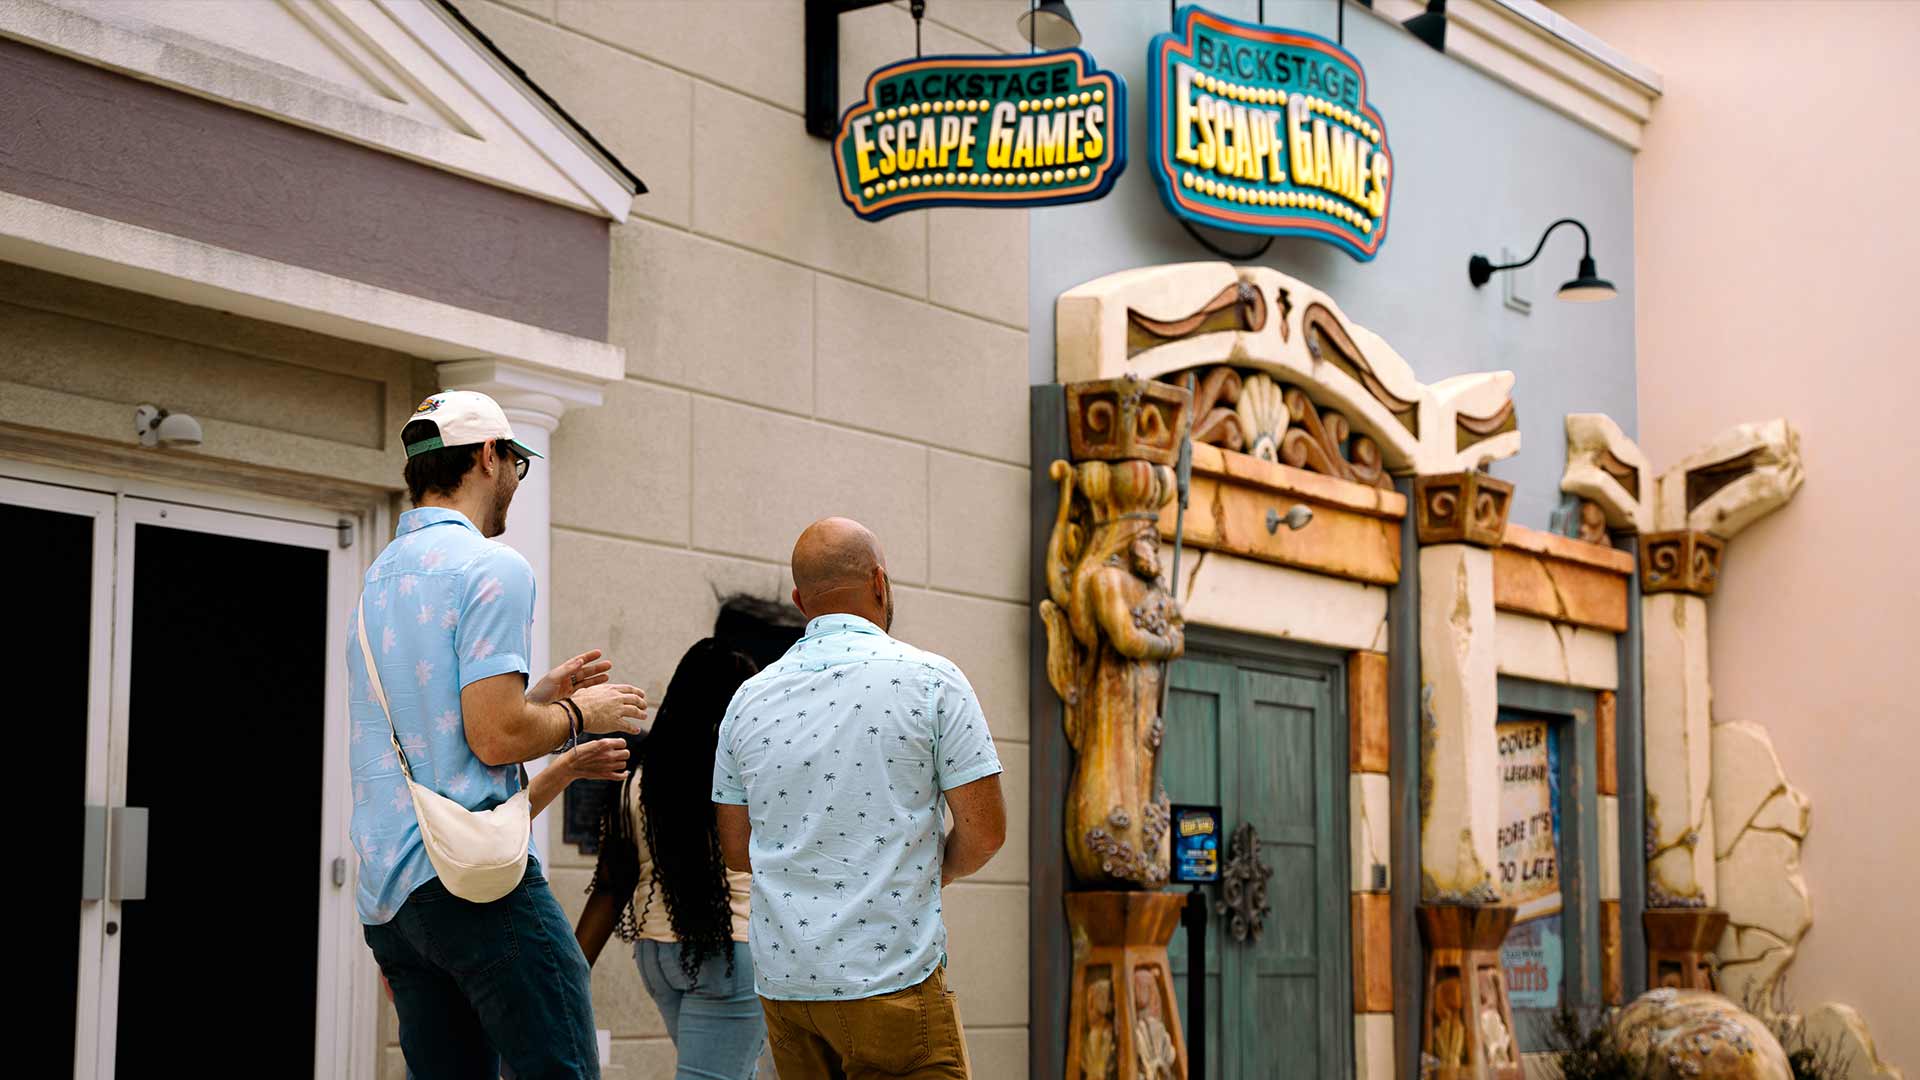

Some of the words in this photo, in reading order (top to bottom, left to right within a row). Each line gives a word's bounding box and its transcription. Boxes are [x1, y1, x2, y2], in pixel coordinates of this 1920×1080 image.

[878, 67, 1071, 107] BACKSTAGE
[1198, 35, 1358, 109] BACKSTAGE
[852, 115, 978, 185] ESCAPE
[986, 101, 1104, 169] GAMES
[1175, 62, 1286, 183] ESCAPE
[1287, 92, 1389, 217] GAMES
[1522, 857, 1555, 880] LATE
